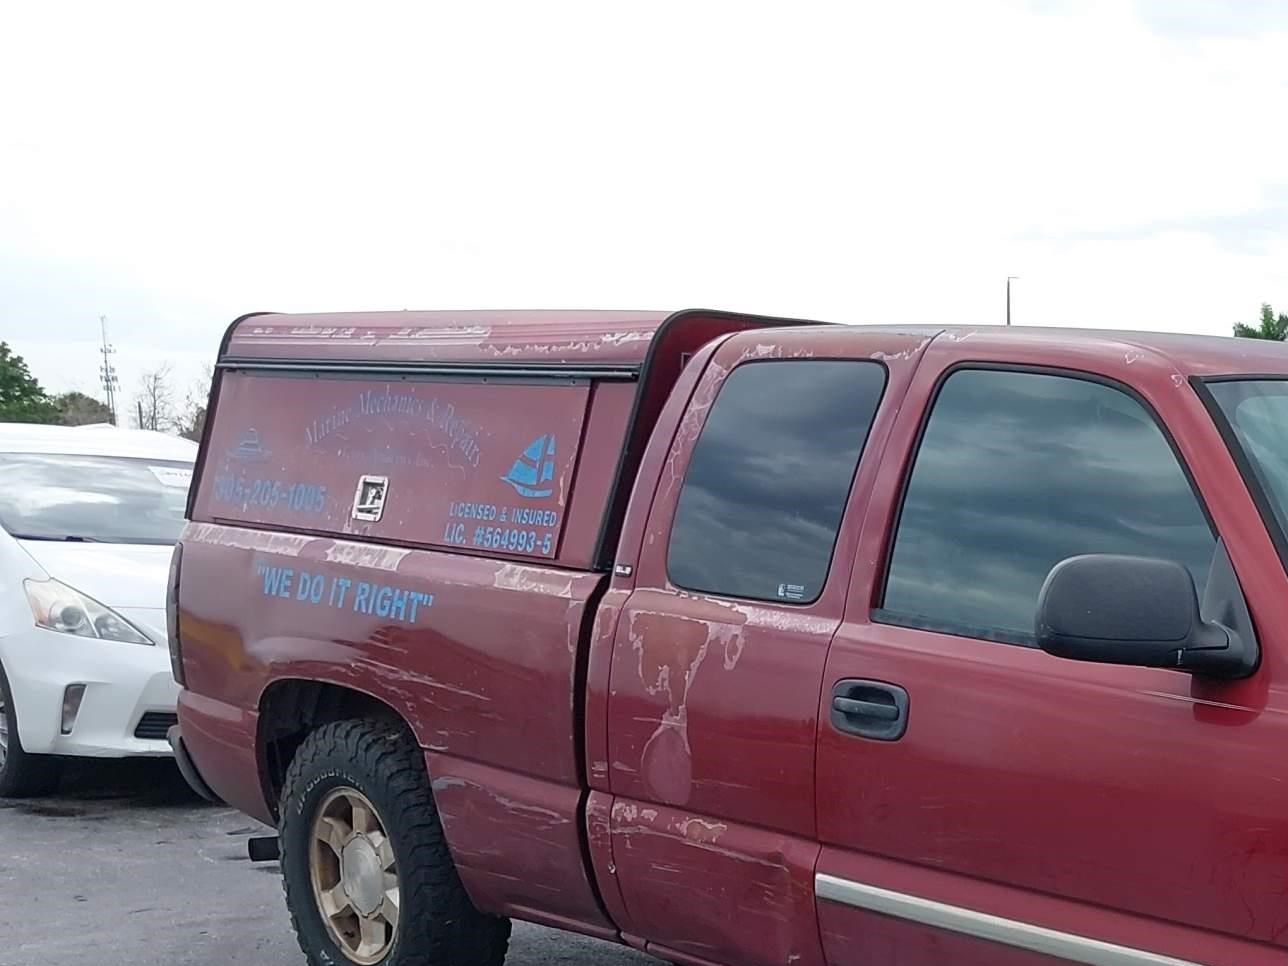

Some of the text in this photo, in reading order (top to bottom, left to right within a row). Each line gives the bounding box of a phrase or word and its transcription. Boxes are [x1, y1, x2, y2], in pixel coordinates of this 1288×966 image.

[449, 502, 557, 527] LICENSED & INSURED
[444, 522, 553, 555] LIC. #564993-5
[257, 565, 434, 624] "WE DO IT RIGHT"
